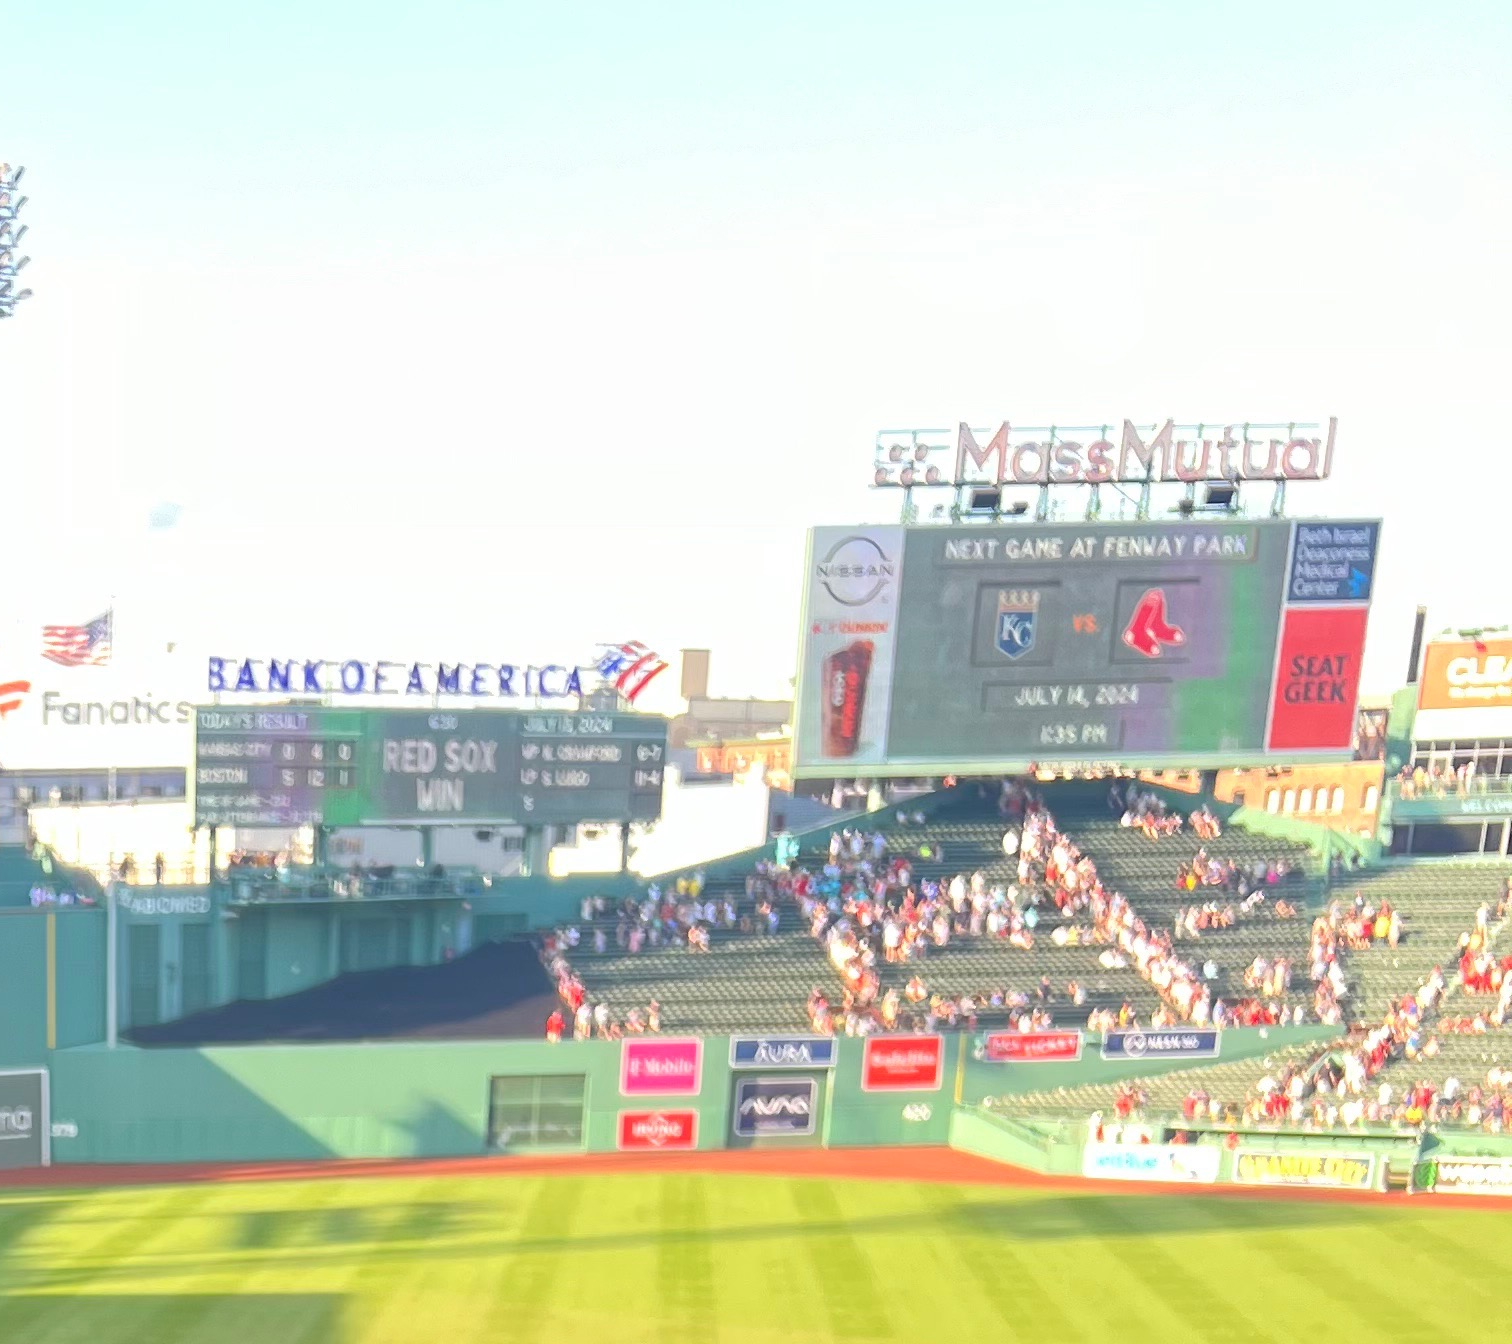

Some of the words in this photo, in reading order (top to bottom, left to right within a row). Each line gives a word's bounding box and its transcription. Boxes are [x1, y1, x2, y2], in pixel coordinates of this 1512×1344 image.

[955, 417, 1338, 483] MassMutual
[944, 537, 999, 560] NEXT
[1005, 536, 1063, 560] GAME
[1069, 537, 1097, 559] AT
[1103, 535, 1186, 557] FENWAY
[1193, 533, 1248, 556] PARK
[815, 563, 894, 578] NISSAN
[208, 656, 324, 694] BANK
[341, 659, 390, 695] OF
[406, 661, 583, 698] AMERICA
[1290, 653, 1349, 677] SEAT
[1015, 685, 1063, 706] JULY
[1284, 680, 1346, 704] GEEK
[42, 691, 193, 726] Fanatics
[382, 738, 436, 773] RED
[443, 738, 499, 773] SOX
[416, 778, 464, 812] WIN
